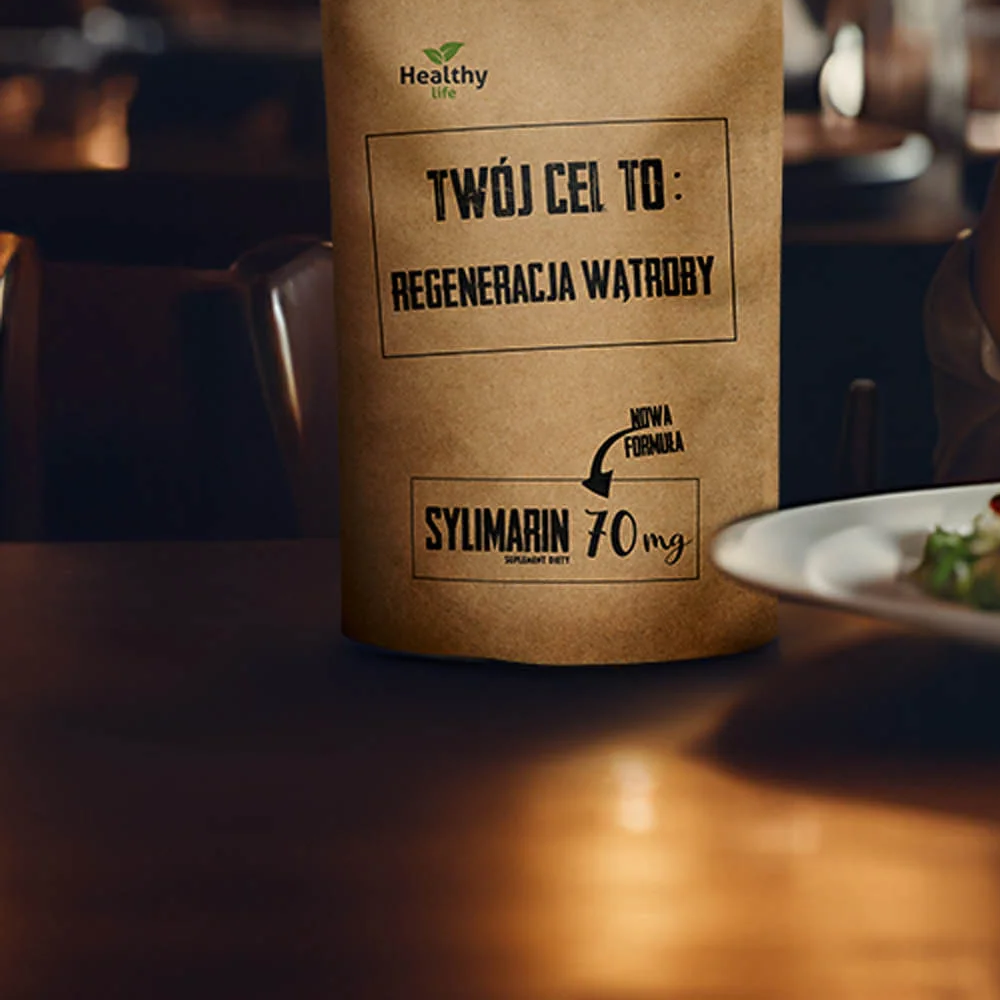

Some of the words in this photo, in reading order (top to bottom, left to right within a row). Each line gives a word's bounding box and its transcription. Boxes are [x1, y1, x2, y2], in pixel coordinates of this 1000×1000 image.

[400, 65, 488, 90] Healthy
[431, 86, 457, 99] life
[426, 156, 533, 222] TWÓJ
[545, 161, 607, 213] CEL
[391, 261, 576, 312] REGENERACJA
[581, 255, 714, 303] WĄTROBY
[630, 404, 673, 429] NOWA
[425, 506, 569, 553] SYLIMARIN
[584, 508, 637, 559] 70
[642, 531, 692, 566] mg
